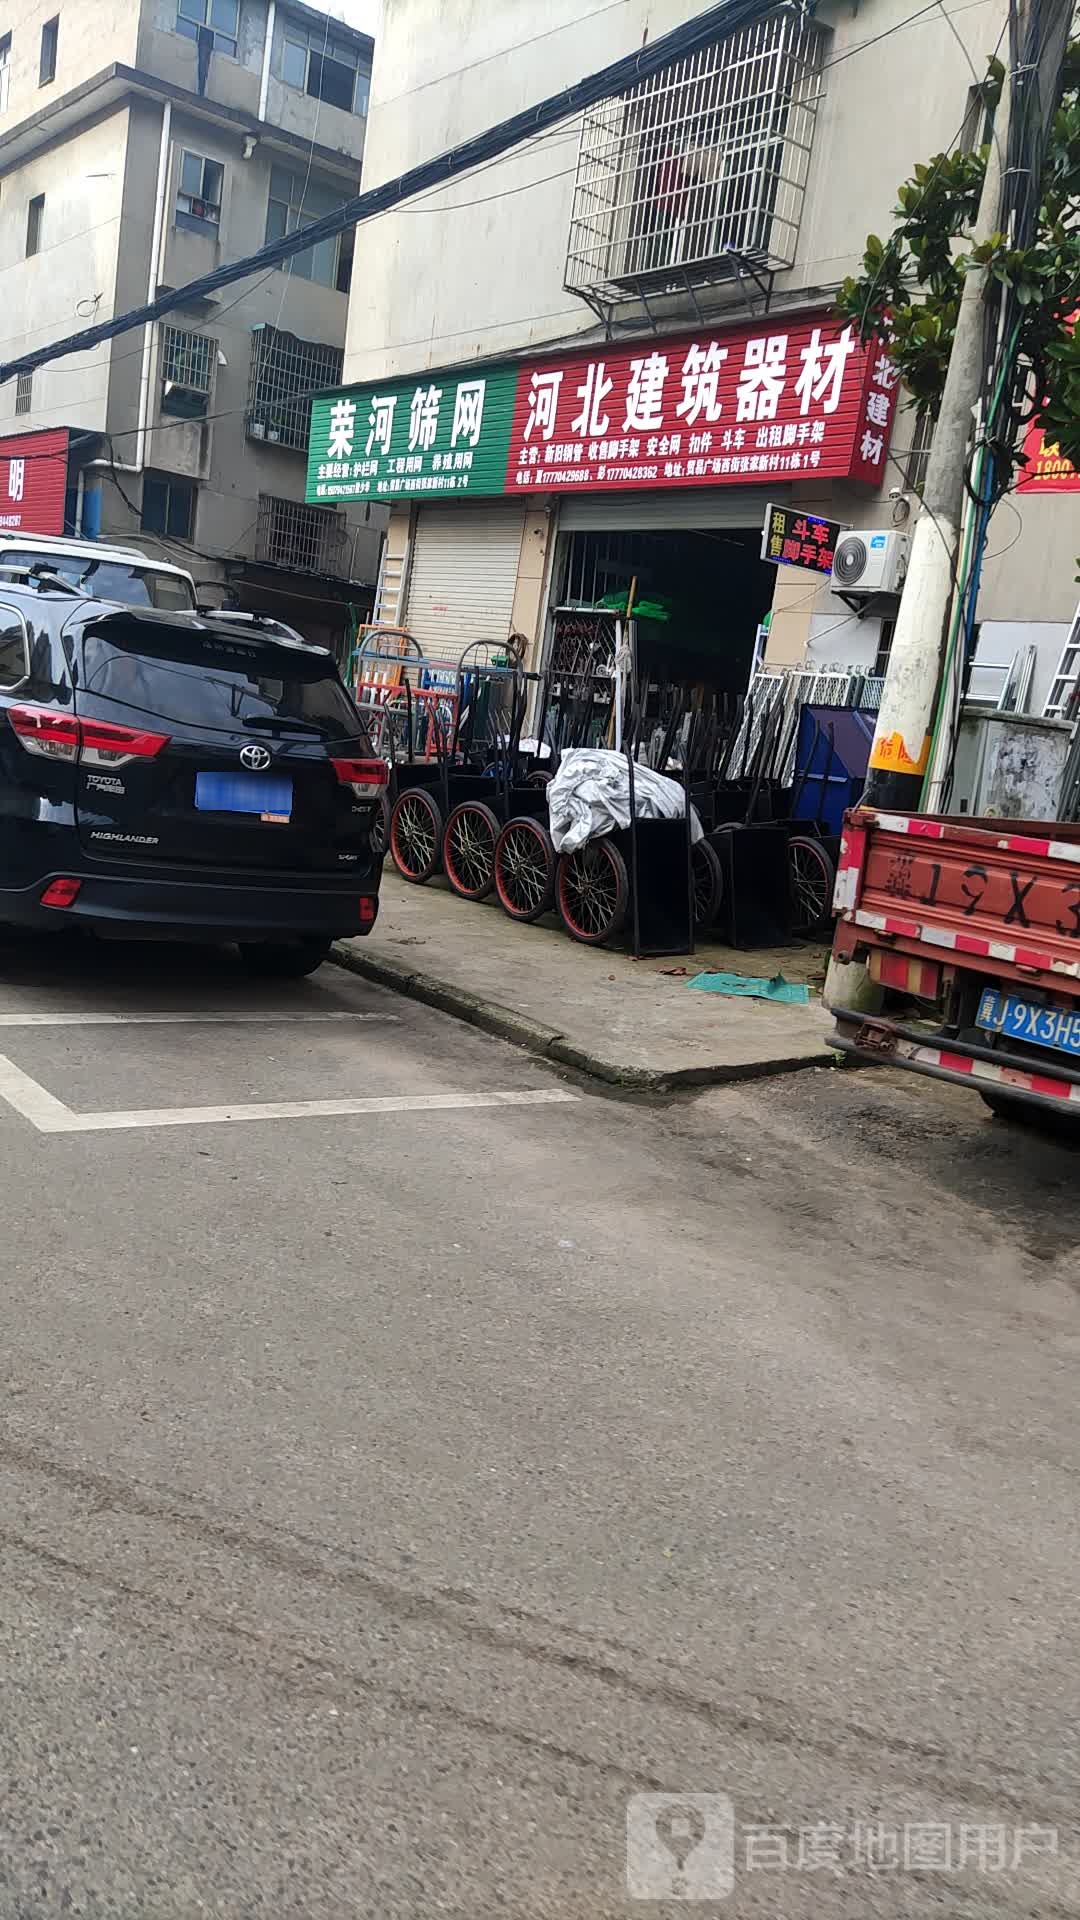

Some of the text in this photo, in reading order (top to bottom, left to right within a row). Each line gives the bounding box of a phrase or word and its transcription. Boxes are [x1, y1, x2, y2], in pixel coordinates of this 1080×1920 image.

[524, 326, 856, 442] 河北建筑器材
[860, 316, 898, 465] 北建材
[327, 379, 486, 460] 荣河筛网
[646, 434, 681, 457] 安全网
[688, 431, 713, 454] 扣件
[720, 428, 747, 451] 斗车
[755, 420, 826, 449] 出租脚手架
[386, 456, 423, 474] 工程用网
[432, 451, 473, 471] 养殖用网
[791, 518, 831, 545] 斗车
[782, 539, 834, 570] 脚手架
[87, 775, 122, 786] TOYOTA
[90, 831, 160, 845] HIGHLANDER
